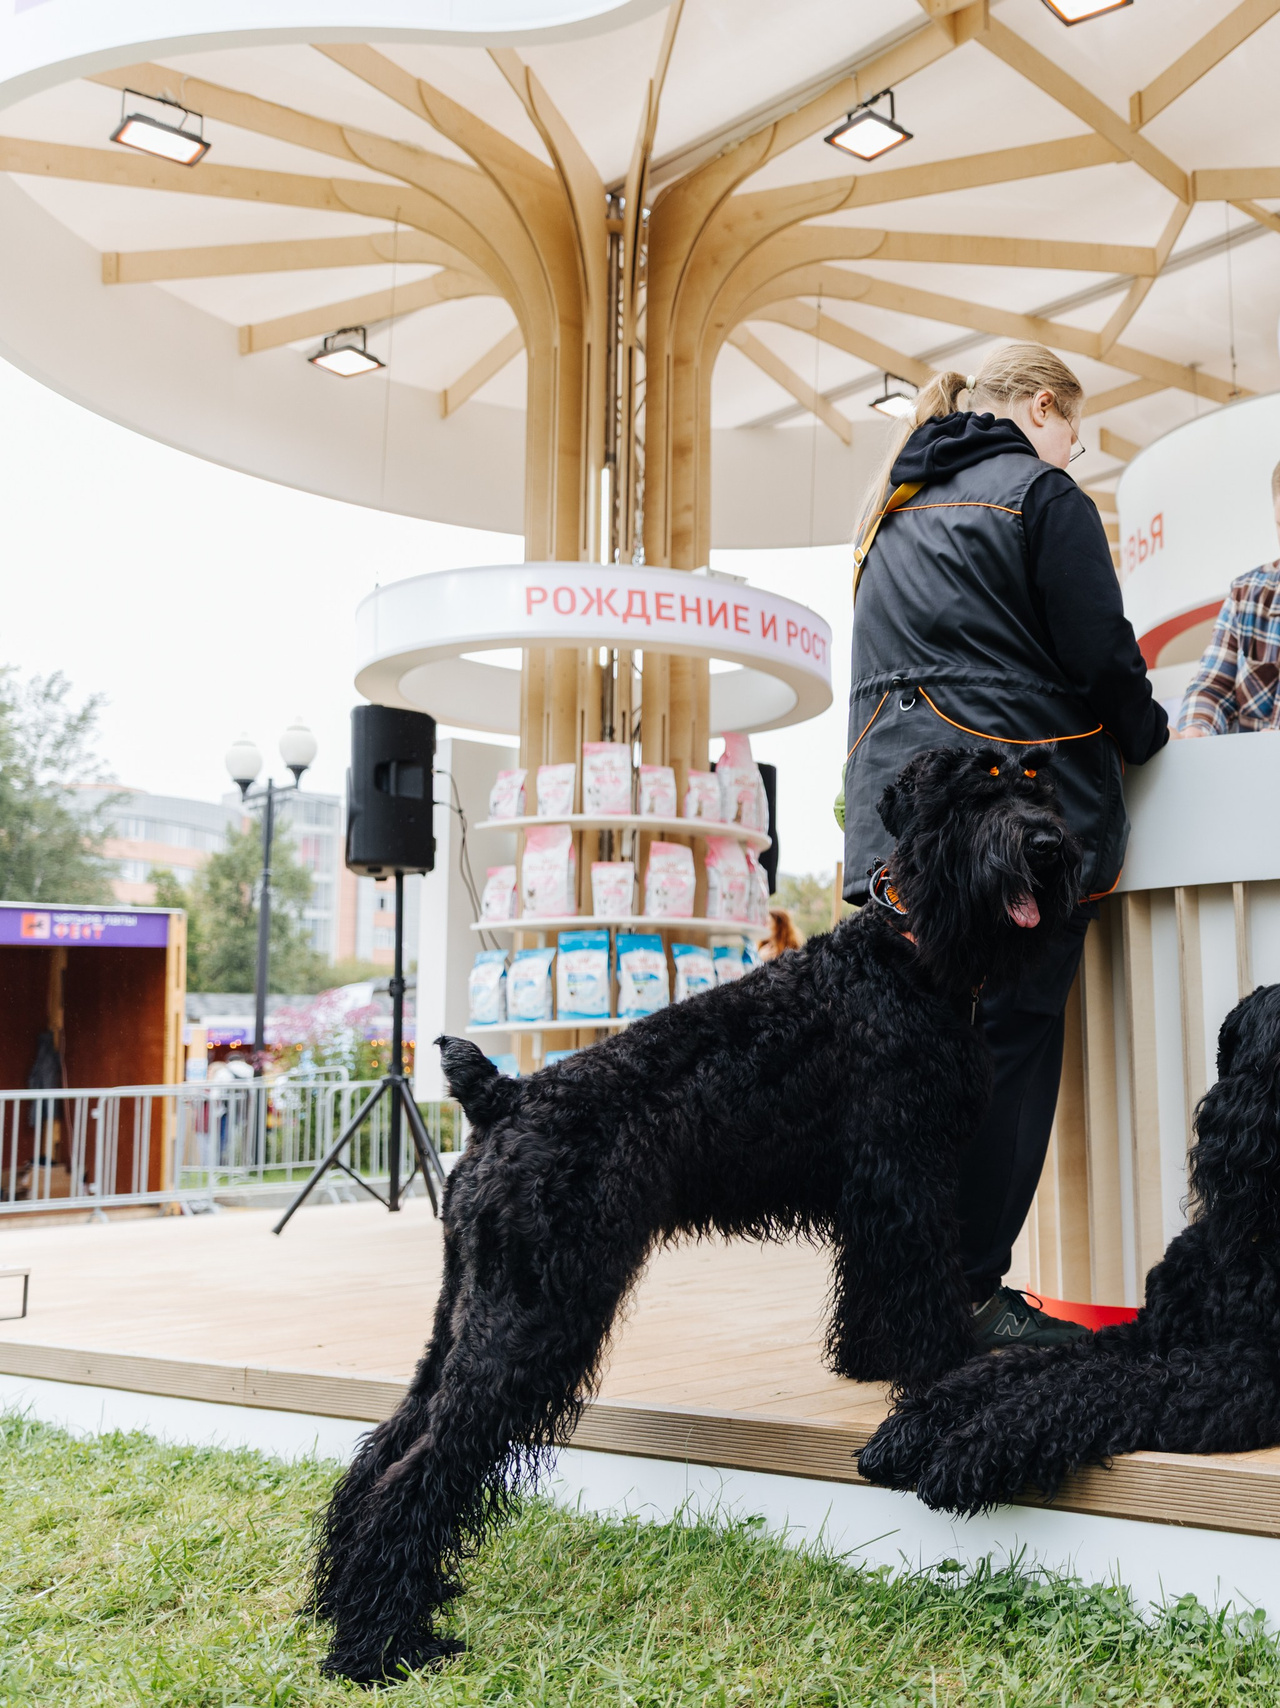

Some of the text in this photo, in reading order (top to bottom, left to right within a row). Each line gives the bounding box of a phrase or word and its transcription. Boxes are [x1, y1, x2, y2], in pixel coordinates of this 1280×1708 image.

[525, 586, 751, 635] РОЖДЕНИЕ
[760, 610, 778, 643] И
[53, 924, 105, 940] ФЕСТ
